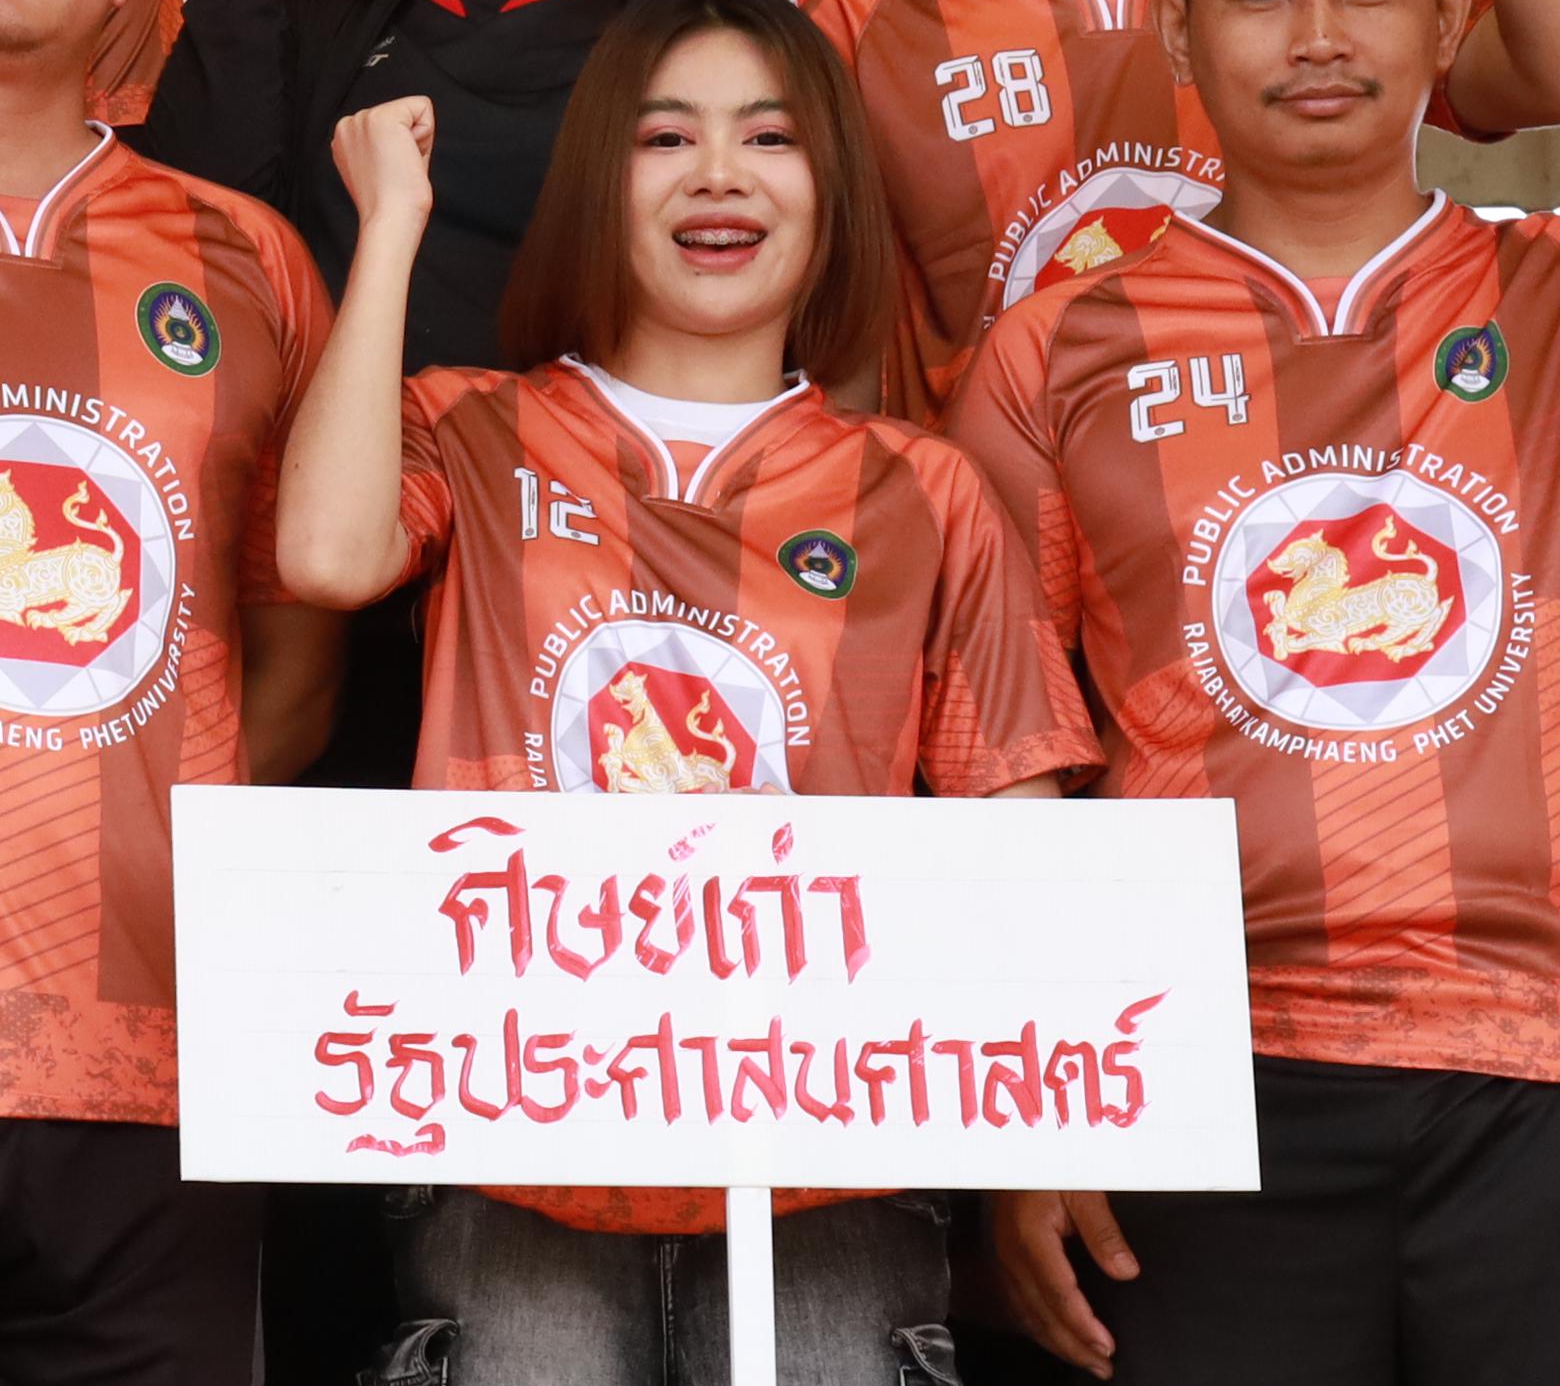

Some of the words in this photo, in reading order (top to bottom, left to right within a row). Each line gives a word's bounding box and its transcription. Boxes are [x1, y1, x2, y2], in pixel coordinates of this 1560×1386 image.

[934, 48, 1052, 142] 28
[988, 185, 1052, 283] PUBLIC
[1058, 143, 1225, 192] ADMINISTR
[1126, 353, 1249, 444] 24
[514, 466, 599, 546] 12
[1182, 475, 1255, 587] PUBLIC
[1261, 443, 1519, 536] ADMINISTRATION
[79, 711, 136, 751] PHET
[131, 583, 196, 728] UNIVERSITY
[530, 594, 606, 700] PUBLIC
[610, 588, 810, 747] ADMINISTRATION
[1240, 714, 1397, 763] KAMPHAENG
[1412, 714, 1477, 755] PHET
[1475, 571, 1536, 716] UNIVERSITY
[428, 815, 873, 984] ศิษย์เก่า
[313, 986, 1172, 1157] รัฐประศาสนศาสตร์
